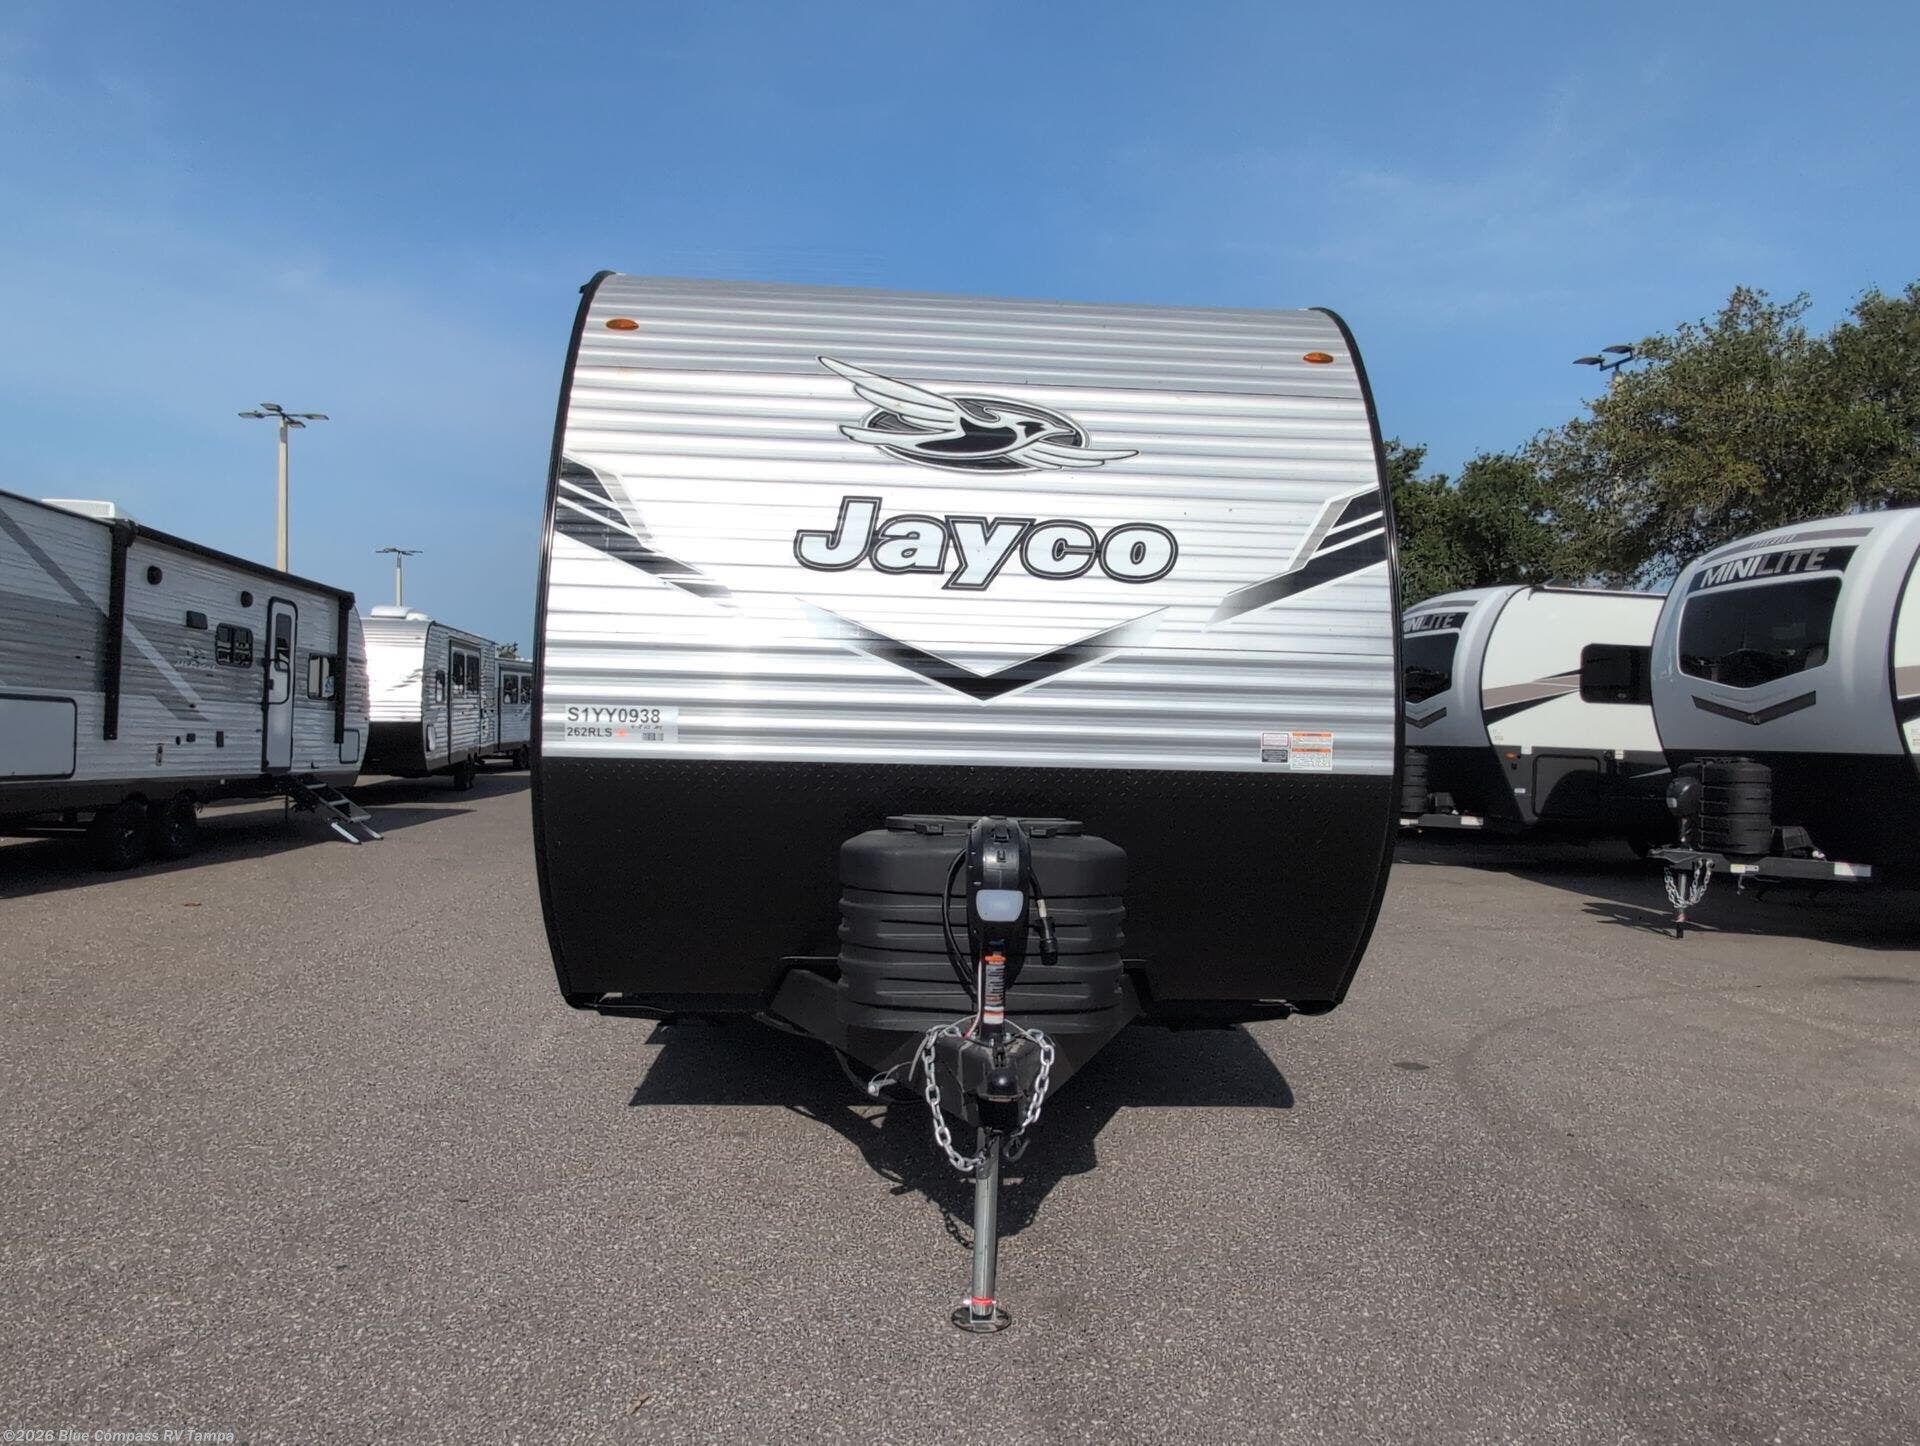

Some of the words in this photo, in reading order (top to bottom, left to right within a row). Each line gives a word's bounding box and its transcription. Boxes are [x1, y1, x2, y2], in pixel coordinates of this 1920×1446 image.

[793, 495, 1179, 591] Jayco
[1700, 547, 1830, 588] MINILITE
[567, 706, 661, 724] S1YY0938
[566, 727, 613, 737] 262RLS
